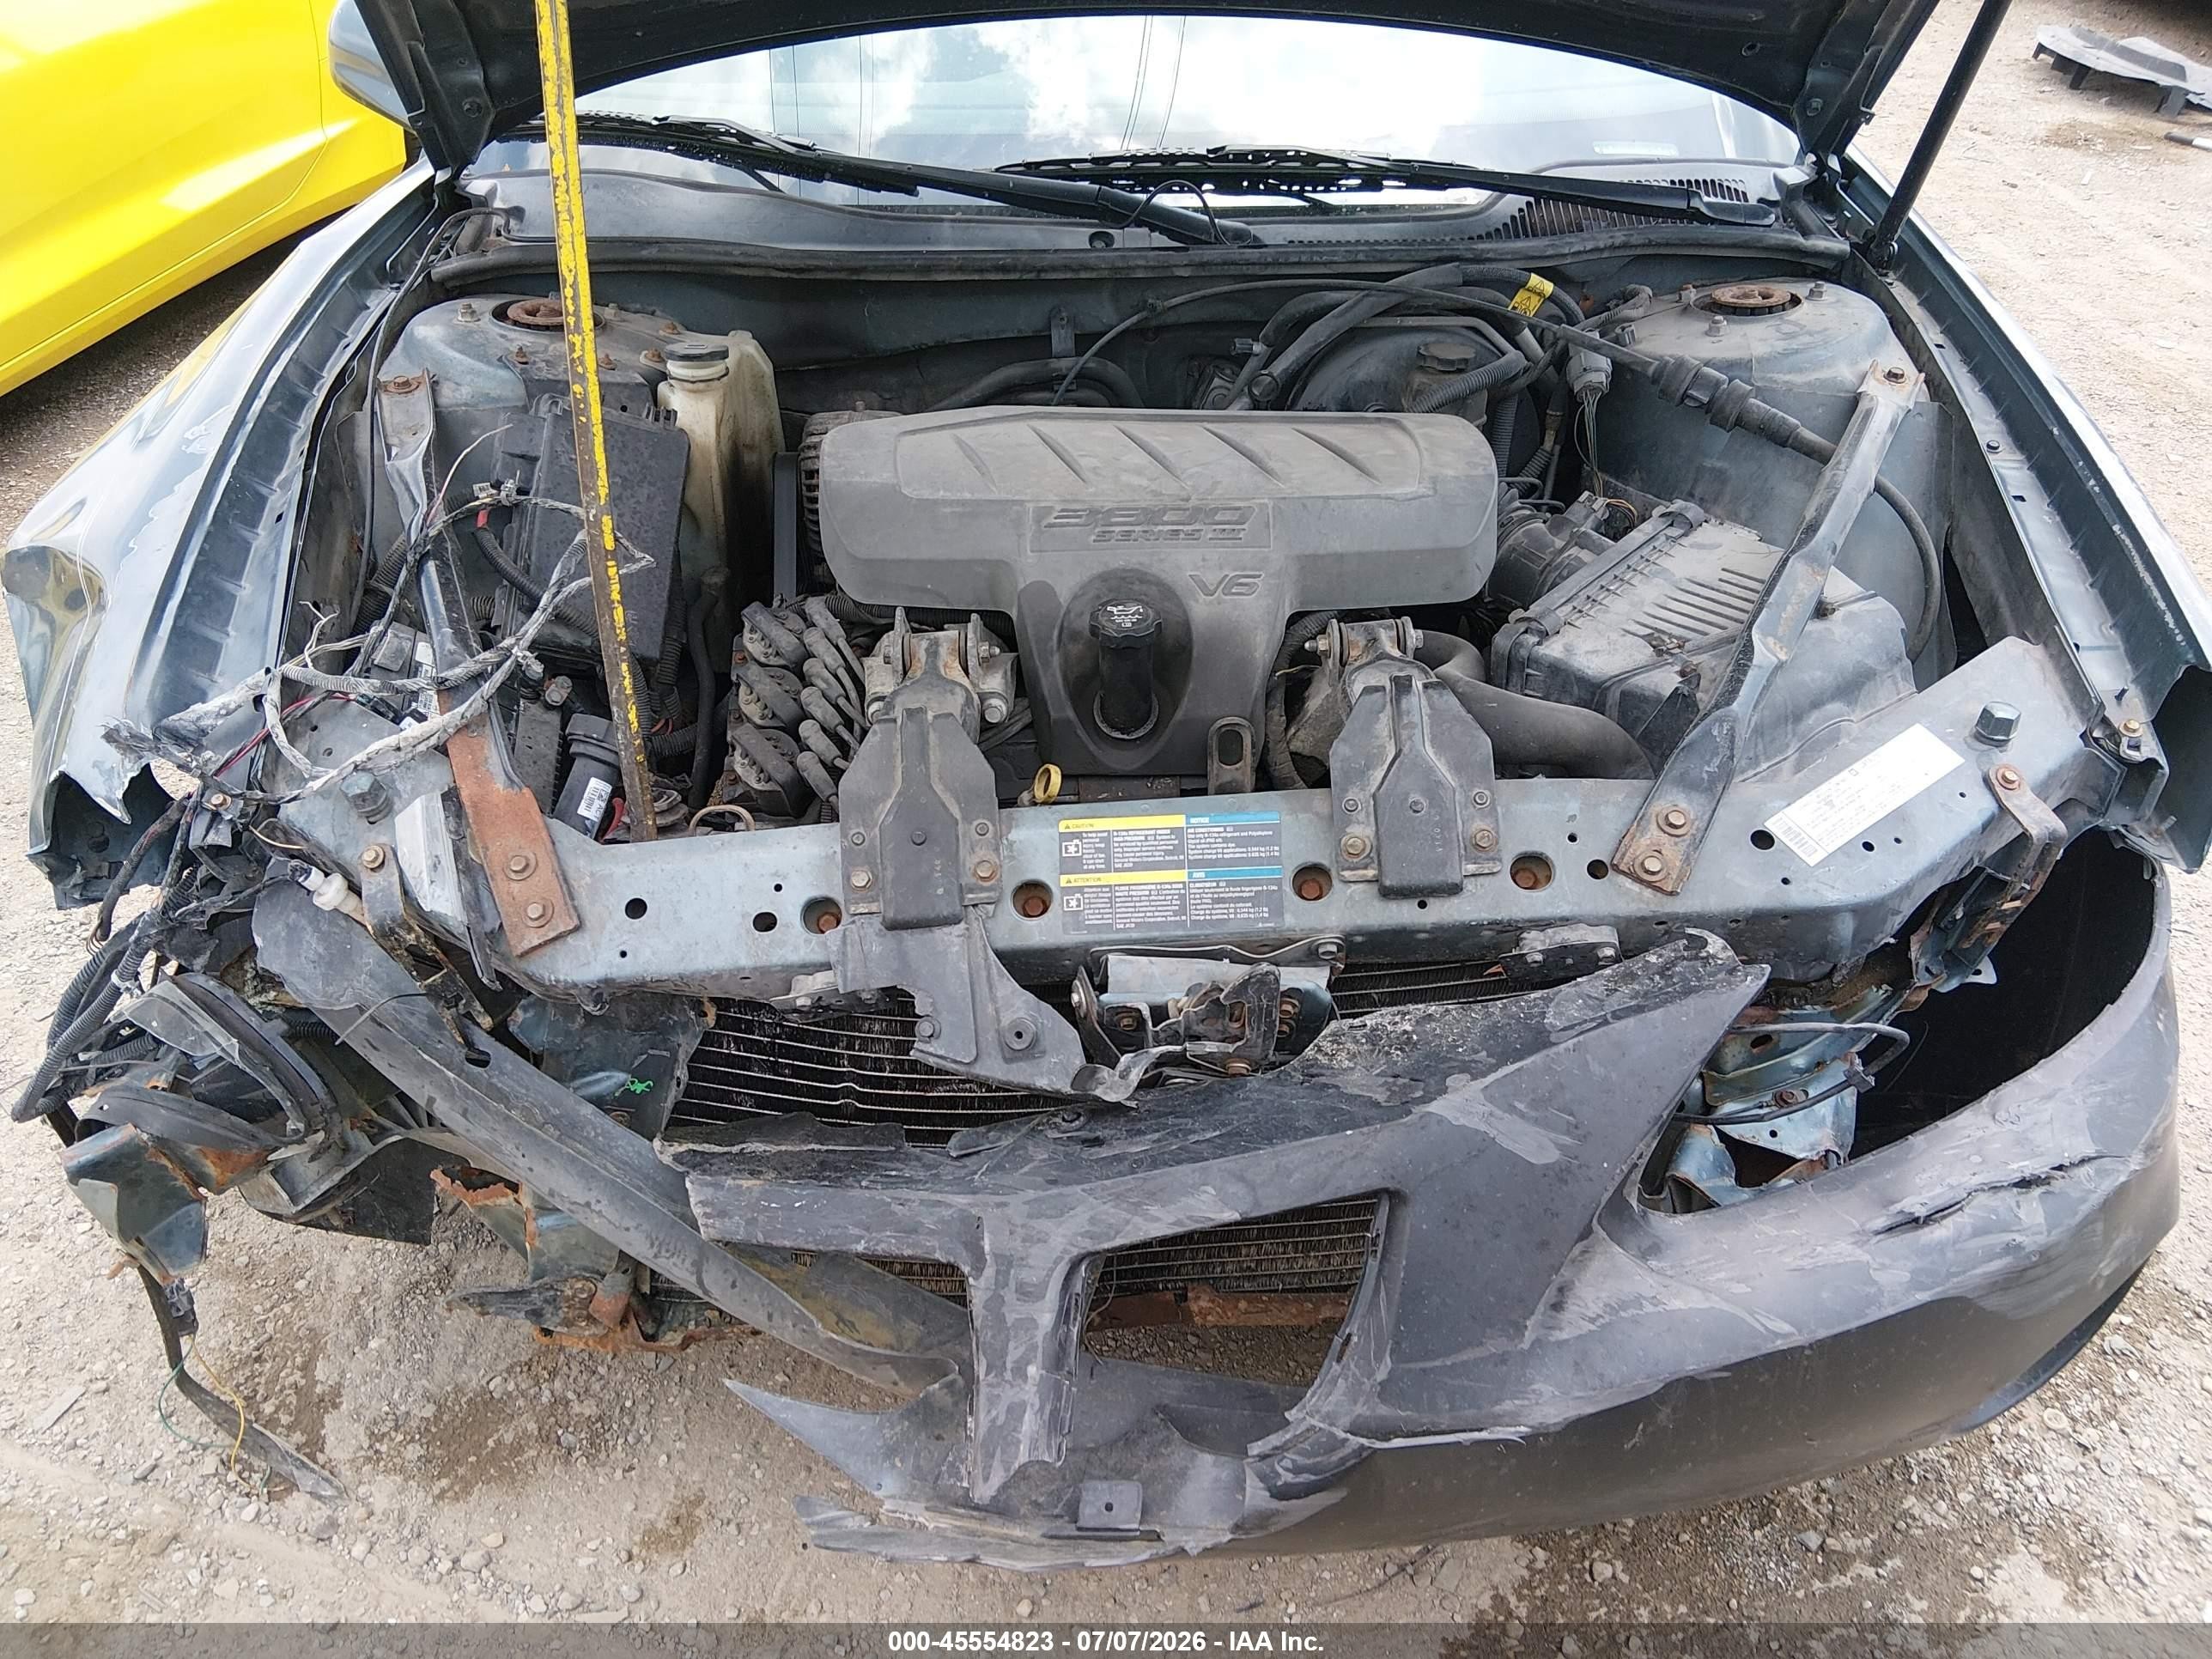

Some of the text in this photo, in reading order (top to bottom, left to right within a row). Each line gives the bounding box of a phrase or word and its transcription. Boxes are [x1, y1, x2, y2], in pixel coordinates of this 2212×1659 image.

[1044, 506, 1256, 529] 3800
[1092, 527, 1204, 543] SERIES
[1188, 572, 1264, 598] V6
